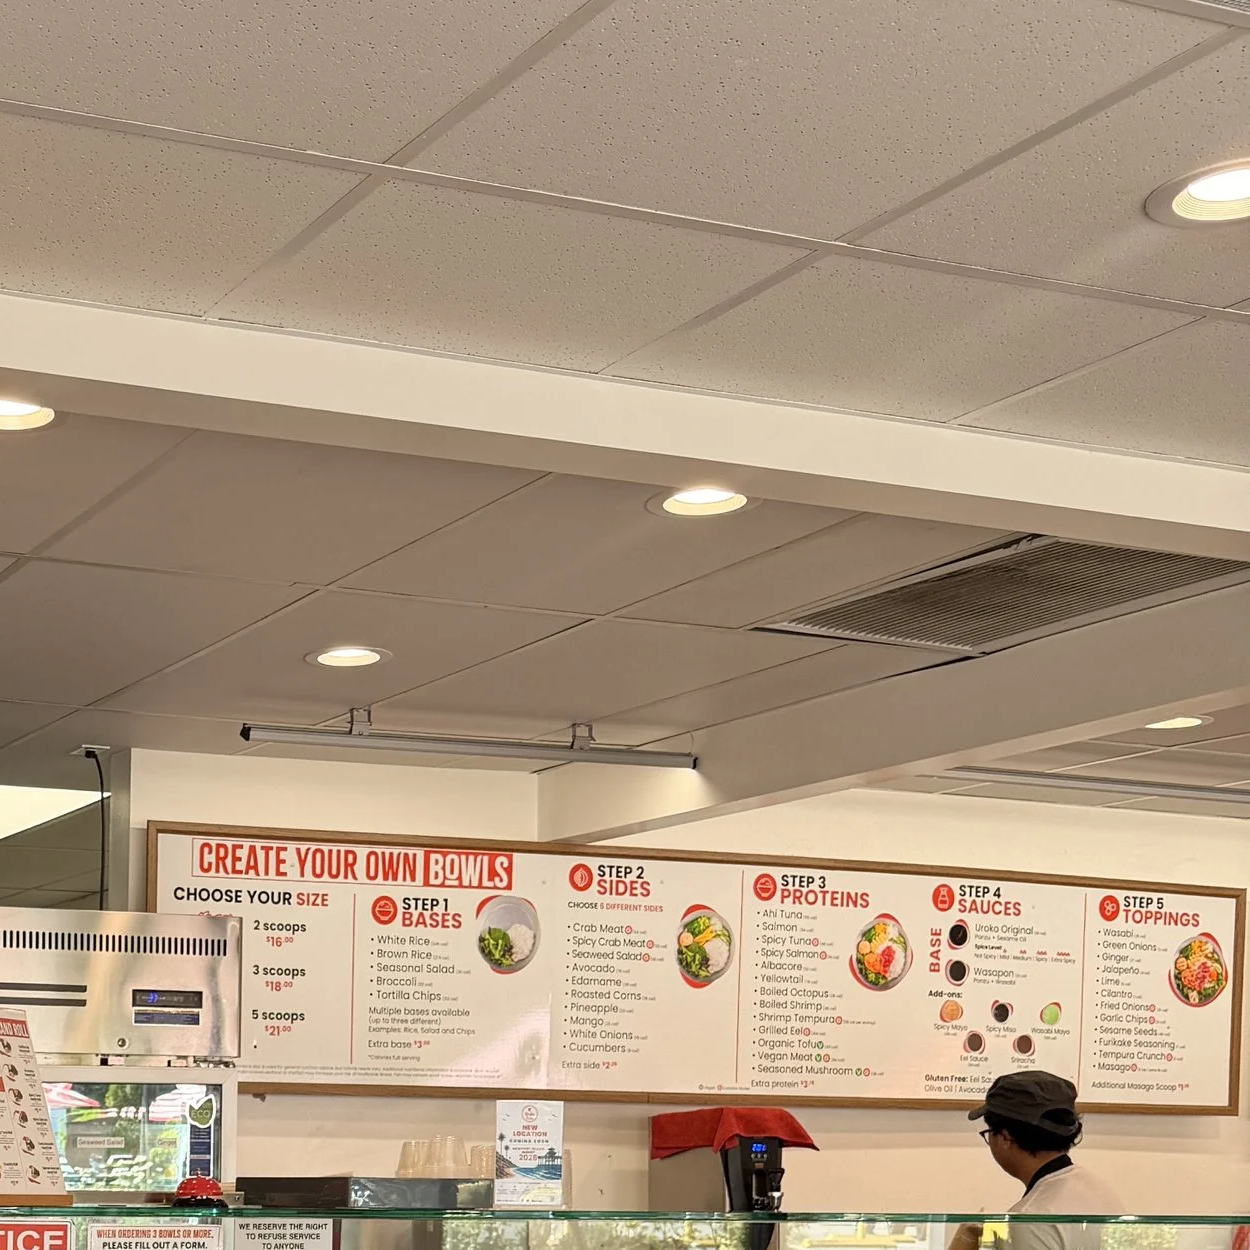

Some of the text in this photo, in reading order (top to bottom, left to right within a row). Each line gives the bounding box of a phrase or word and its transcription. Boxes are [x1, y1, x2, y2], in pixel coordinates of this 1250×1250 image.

[199, 842, 509, 888] CREATE YOUR OWN BOWLS
[597, 865, 644, 879] STEP 2
[781, 875, 826, 888] STEP 3
[597, 879, 650, 897] SIDES
[959, 885, 1001, 899] STEP 4
[174, 887, 329, 907] CHOOSE YOUR SIZE
[781, 889, 870, 908] PROTEINS
[1124, 896, 1164, 909] STEP 5
[402, 897, 448, 912] STEP 1
[958, 899, 1021, 916] SAUCES
[402, 912, 462, 929] BASES
[763, 909, 803, 920] Ahi Tuna
[1123, 909, 1200, 927] TOPPINGS
[254, 920, 307, 935] 2 scoops
[573, 923, 624, 934] Crab Meat
[762, 922, 797, 932] Salmon
[975, 924, 1033, 935] Uroko Original
[1103, 928, 1133, 938] Wasabi
[266, 936, 294, 948] $16.00
[377, 935, 406, 946] White
[409, 936, 430, 946] Rice
[1103, 941, 1157, 951] Green Onions
[377, 949, 408, 959] Brown
[411, 950, 432, 960] Rice
[929, 928, 942, 973] BASE
[1102, 953, 1129, 964] Ginger
[253, 965, 306, 979] 3 scoops
[377, 963, 423, 973] Seasonal
[426, 964, 455, 974] Salad
[572, 963, 615, 973] Avocado
[974, 967, 1014, 979] Wasapon
[265, 981, 293, 992] $18.00
[377, 977, 417, 986] Broccoli
[572, 976, 621, 986] Edamame
[377, 990, 410, 1000] Tortilla
[412, 991, 442, 1002] Chips
[571, 990, 641, 1001] Roasted Corns
[760, 988, 829, 1000] Boiled Octopus
[928, 990, 963, 999] Add-ons:
[570, 1003, 618, 1015] Pineapple
[252, 1009, 305, 1024] 5 scoops
[12, 1023, 28, 1037] ROLL
[265, 1025, 292, 1036] $21.00
[758, 1039, 817, 1050] Organic Tofu
[1099, 1038, 1175, 1051] Furikake Seasoning
[191, 1109, 210, 1118] ECO
[97, 1229, 116, 1238] WHEN
[118, 1230, 151, 1238] ORDERING
[153, 1230, 156, 1238] 3
[158, 1230, 181, 1238] BOWLS
[182, 1230, 191, 1238] OR
[262, 1242, 304, 1250] TO ANYONE
